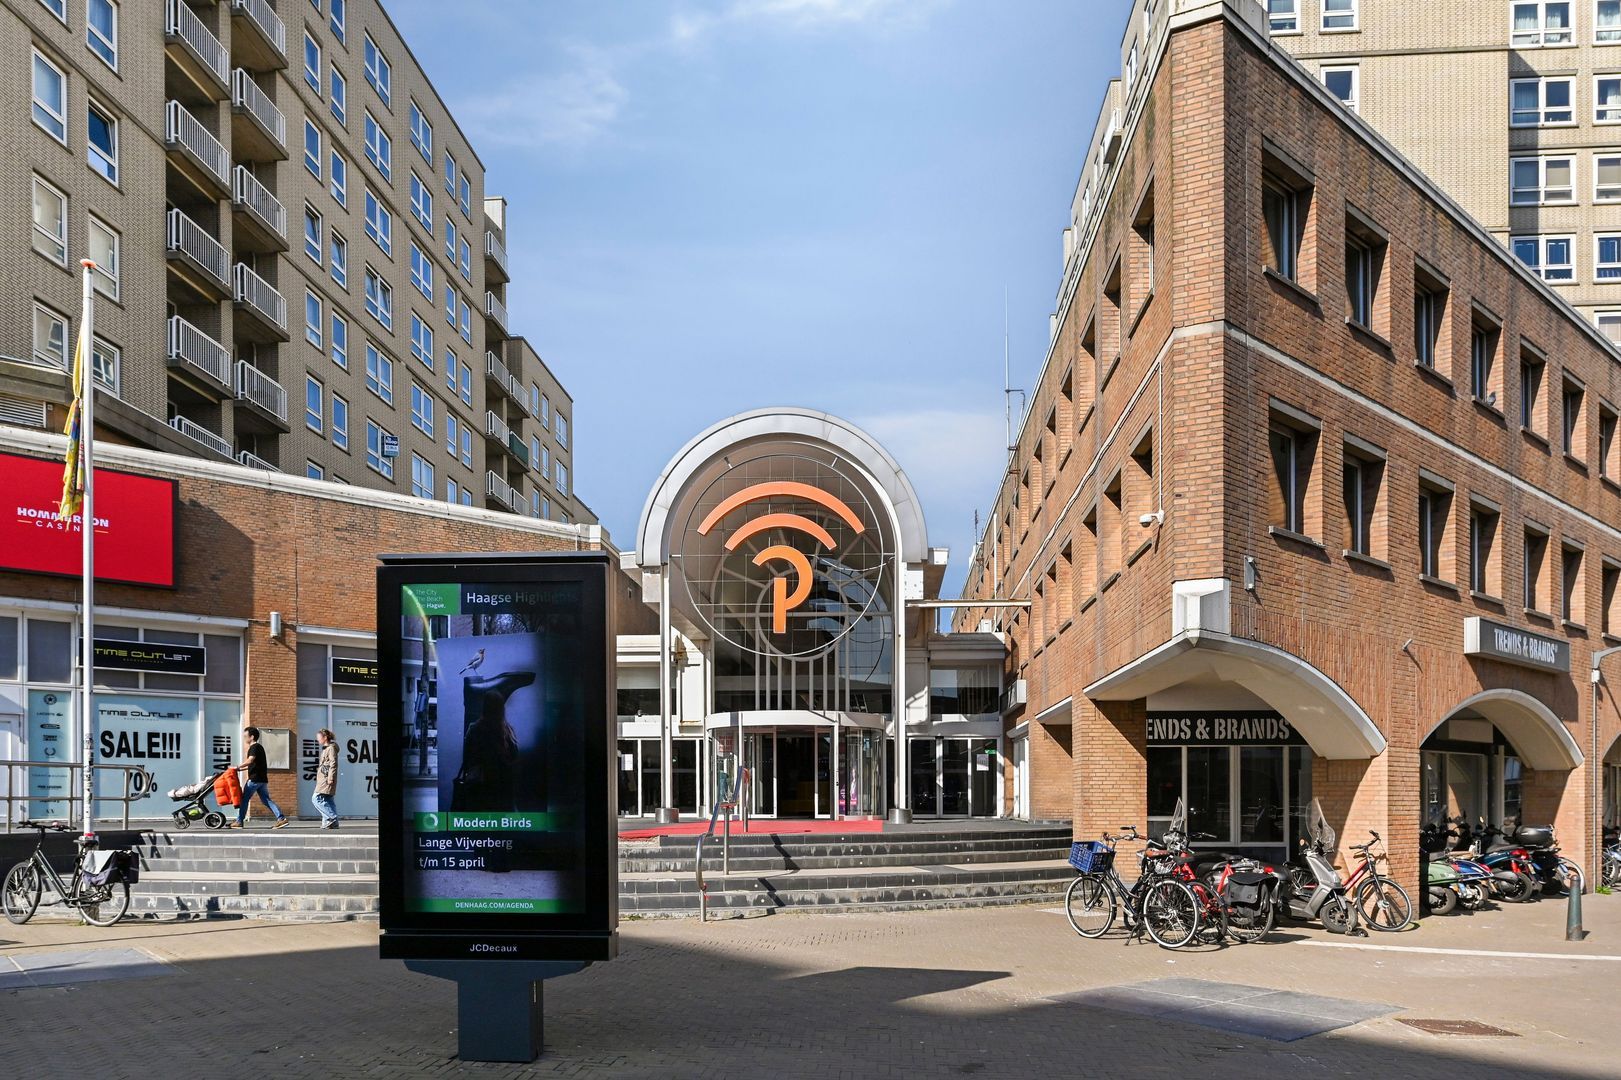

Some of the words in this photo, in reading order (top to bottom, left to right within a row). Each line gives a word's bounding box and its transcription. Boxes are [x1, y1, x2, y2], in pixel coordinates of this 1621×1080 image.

[17, 507, 109, 527] HOMMRON
[36, 520, 81, 532] CASN
[466, 592, 512, 606] Haagse
[1494, 628, 1522, 656] TRENDS
[1522, 636, 1529, 657] &
[94, 648, 128, 657] TIME
[131, 651, 191, 661] OUTLET
[339, 665, 369, 674] TIME
[130, 711, 183, 719] OUTLET
[1195, 718, 1211, 740] &
[1214, 718, 1291, 740] BRANDS
[100, 730, 181, 759] SALE!!!
[213, 735, 231, 775] ALE!!!
[303, 739, 320, 781] SALE!!!
[453, 817, 498, 828] Modern
[501, 817, 532, 828] Birds
[419, 837, 452, 849] Lange
[455, 837, 513, 849] Vijverberg
[419, 857, 439, 868] t/m
[441, 857, 455, 867] 15
[458, 857, 485, 869] april
[469, 944, 518, 952] JCDecaux
